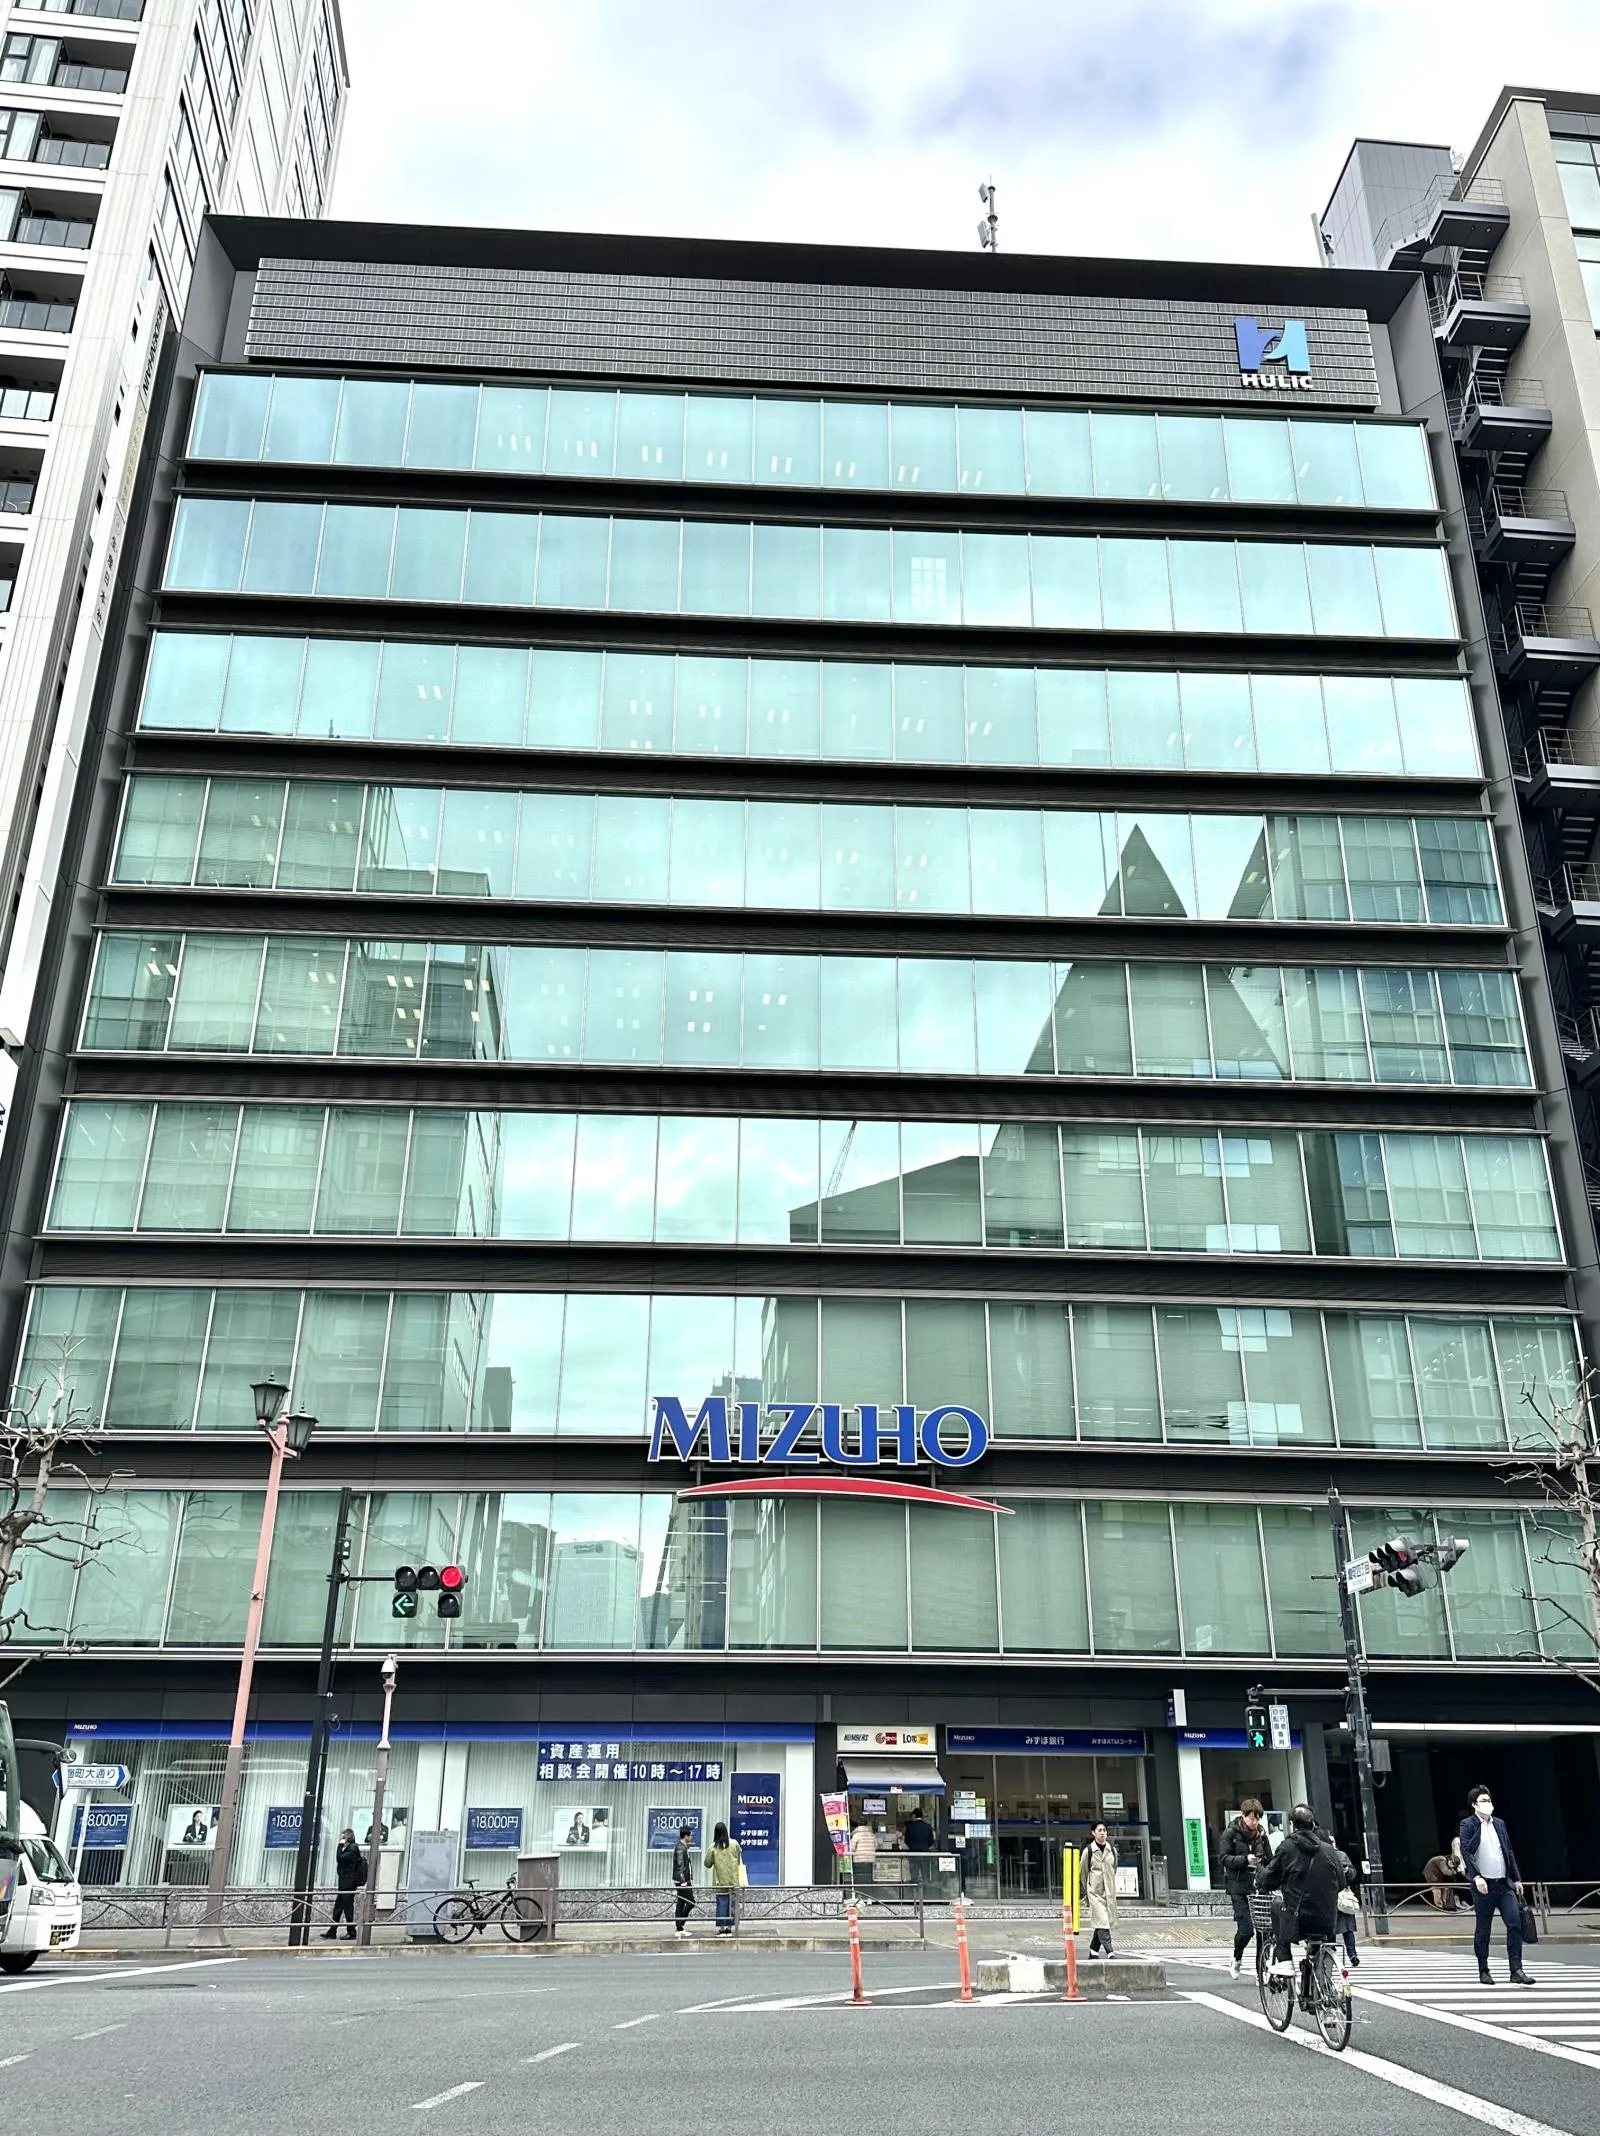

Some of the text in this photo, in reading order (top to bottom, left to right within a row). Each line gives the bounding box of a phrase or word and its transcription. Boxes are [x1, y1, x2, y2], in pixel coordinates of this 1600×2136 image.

[142, 298, 165, 397] HEIDENHAIN
[1241, 373, 1314, 389] HULIC
[647, 1396, 989, 1467] MIZUHO
[1025, 1736, 1065, 1746] みずほ銀行
[737, 1794, 774, 1804] MIZUHO
[87, 1814, 128, 1827] 8,000円
[276, 1814, 302, 1828] 18,00
